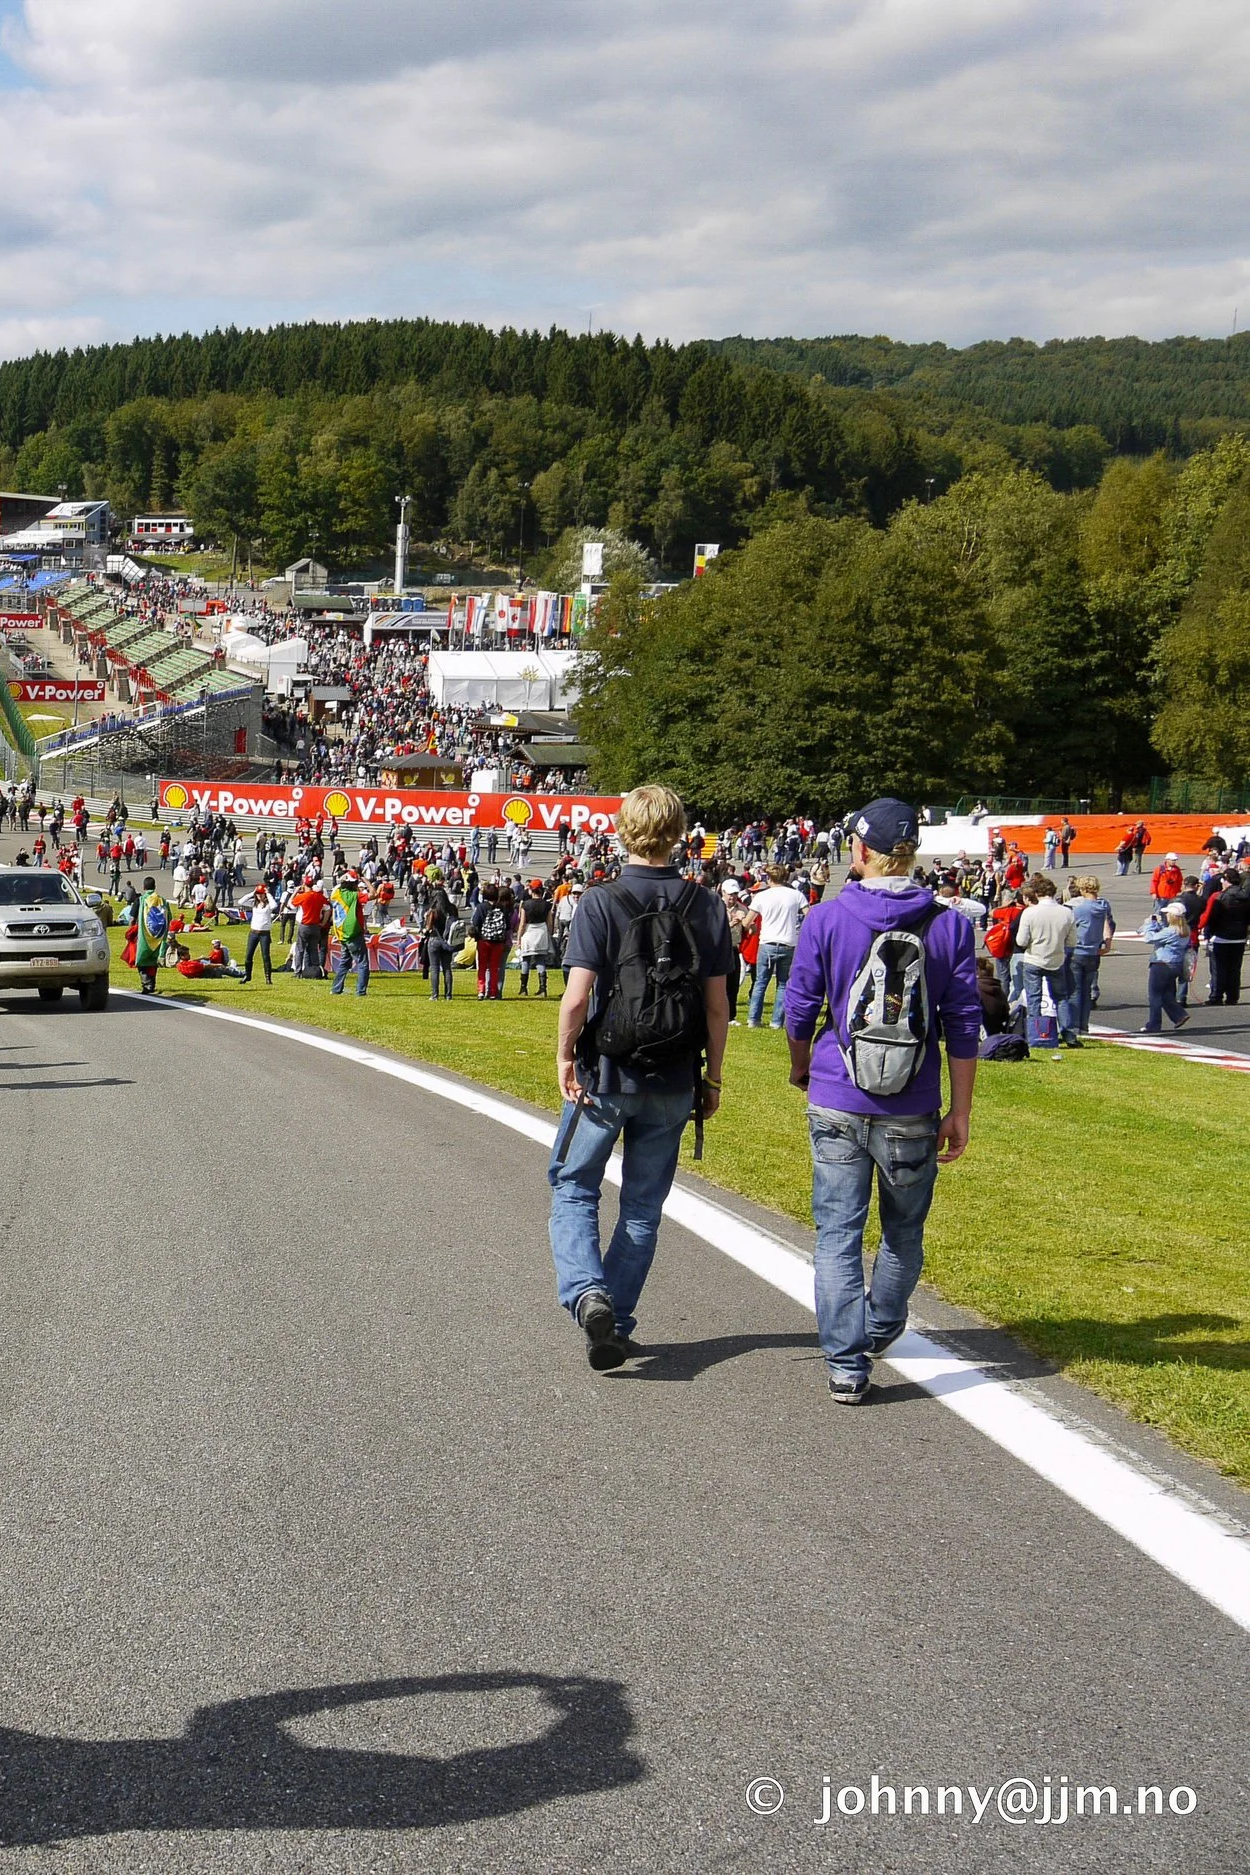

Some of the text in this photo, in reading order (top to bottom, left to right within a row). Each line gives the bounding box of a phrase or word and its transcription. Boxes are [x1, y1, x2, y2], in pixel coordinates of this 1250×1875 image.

[26, 685, 102, 700] V-Power
[192, 789, 299, 817] V-Power
[355, 796, 476, 825] V-Power
[898, 821, 909, 837] 7
